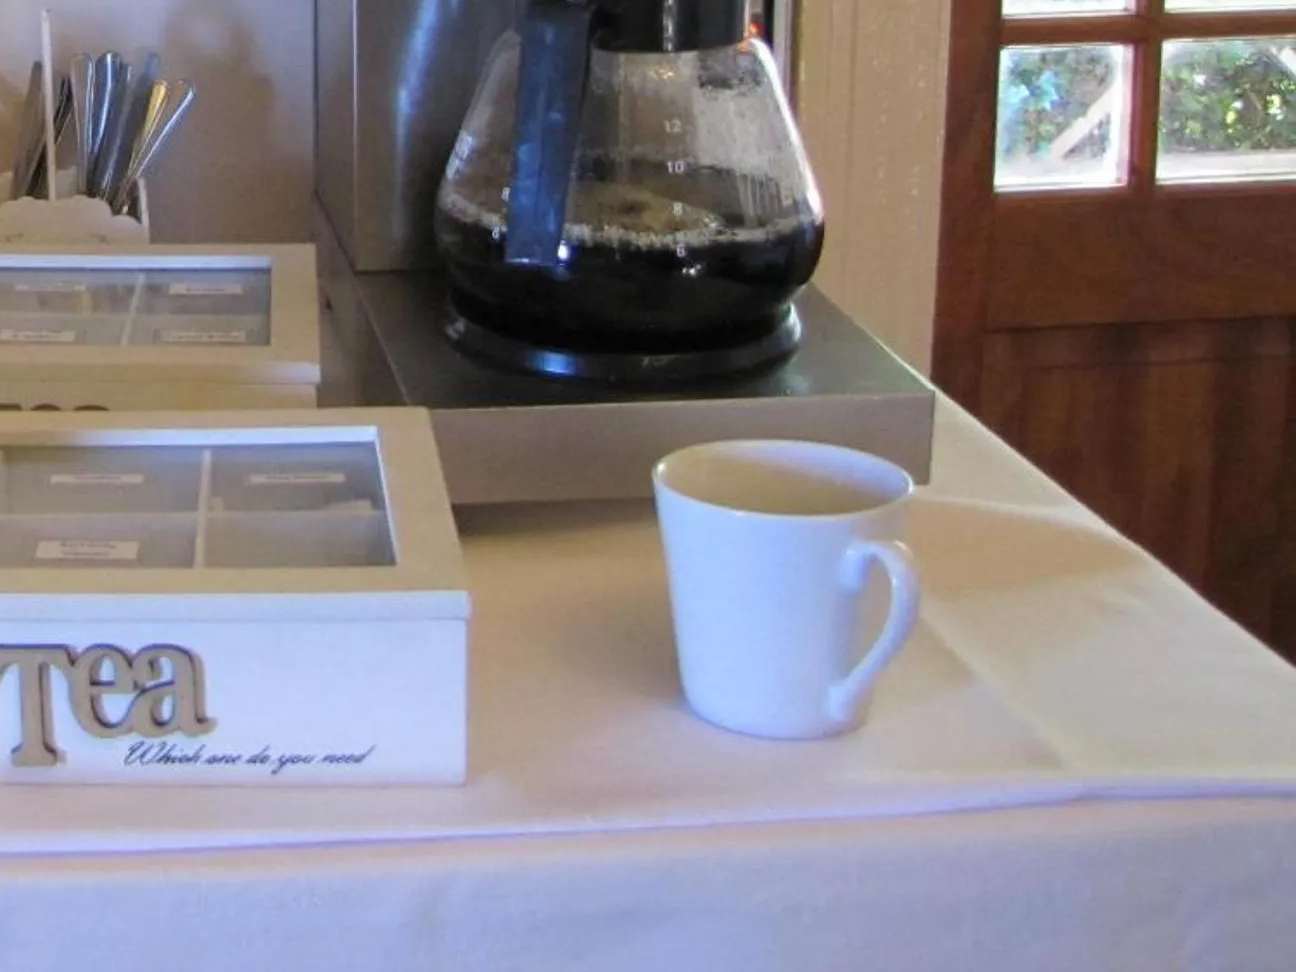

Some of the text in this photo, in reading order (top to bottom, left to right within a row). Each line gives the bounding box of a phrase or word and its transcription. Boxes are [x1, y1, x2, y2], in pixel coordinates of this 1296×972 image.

[664, 118, 682, 133] 12
[667, 160, 685, 174] 10
[123, 740, 377, 776] Which one do you need
